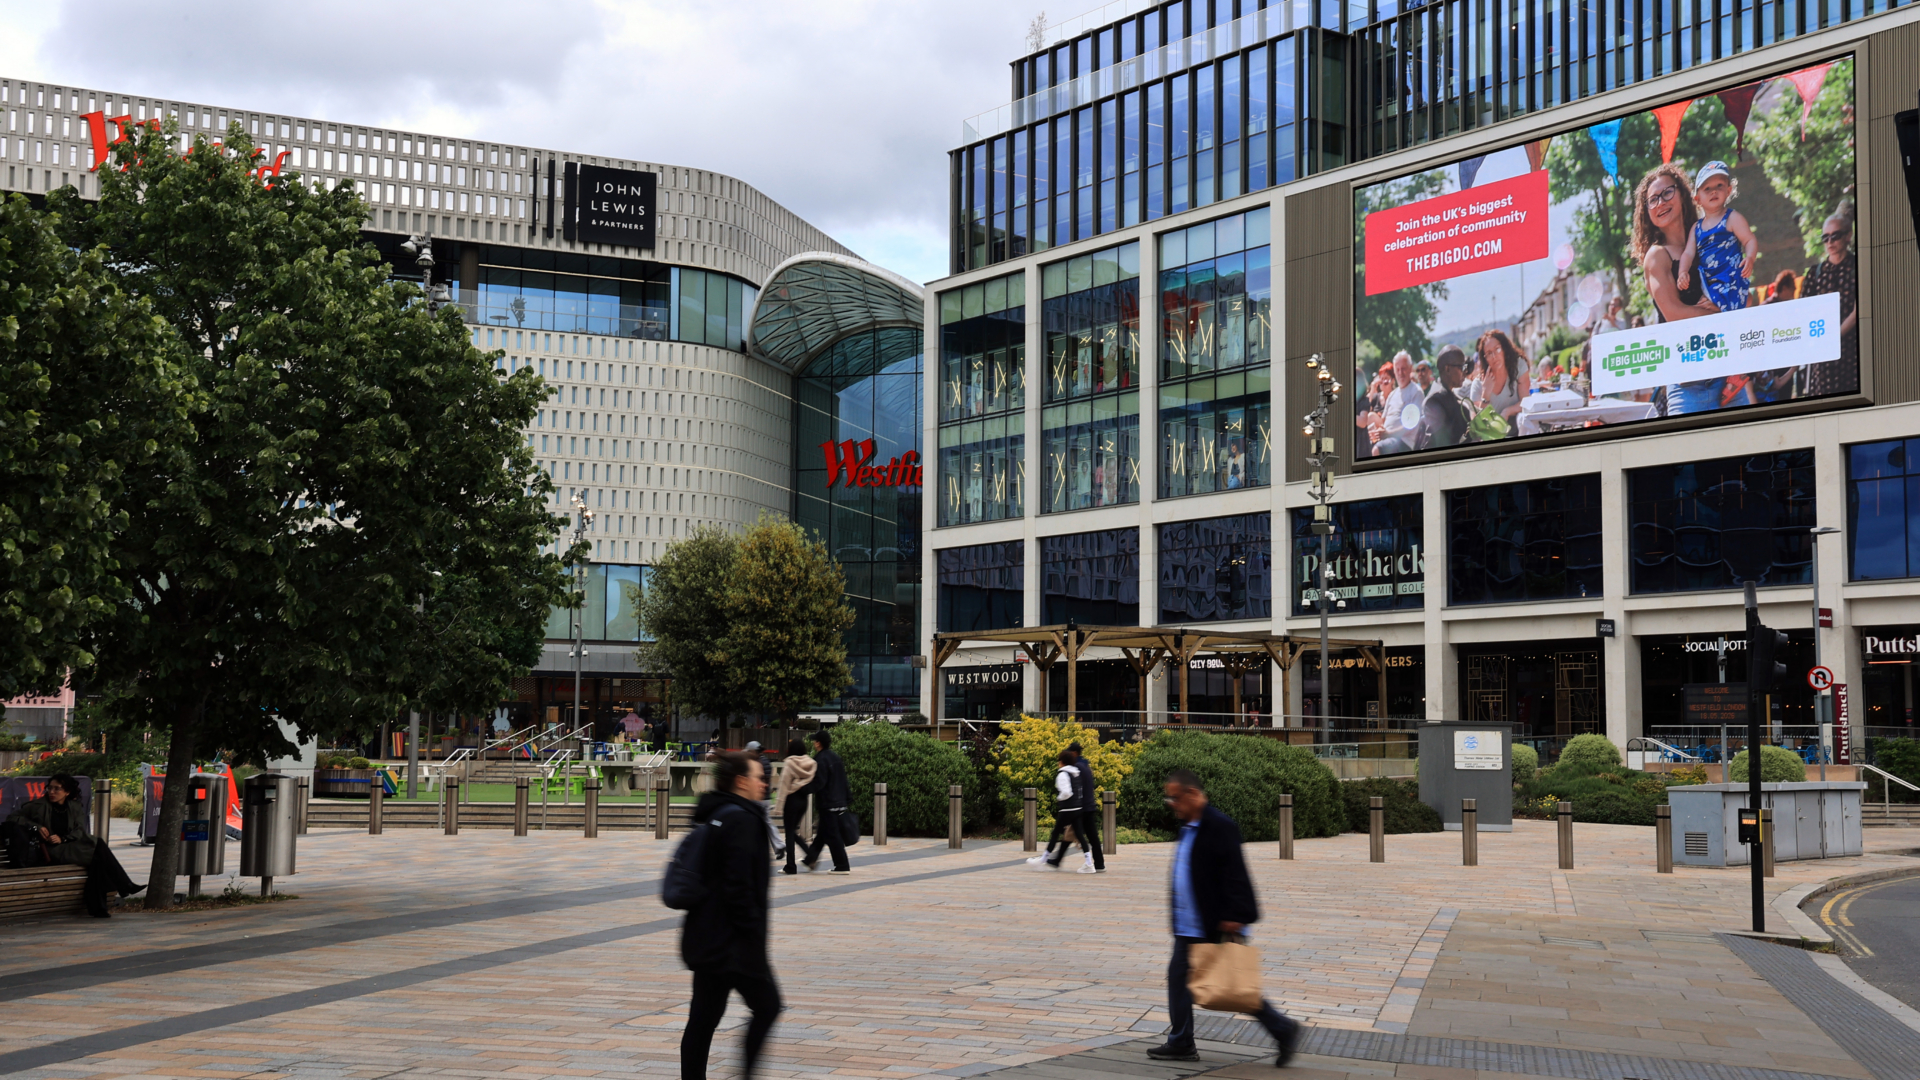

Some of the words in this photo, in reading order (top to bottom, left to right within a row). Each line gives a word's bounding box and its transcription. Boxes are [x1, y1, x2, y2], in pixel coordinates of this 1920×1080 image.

[595, 181, 641, 196] JOHN
[591, 200, 645, 215] LEWIS
[1396, 218, 1420, 233] Join
[1421, 215, 1441, 227] the
[1469, 194, 1513, 216] biggest
[599, 220, 644, 230] PARTNERS
[1384, 229, 1446, 252] celebration
[1447, 224, 1460, 237] of
[1461, 210, 1527, 234] community
[1406, 238, 1502, 273] THEBIGDO.COM
[1739, 329, 1765, 342] eden
[1772, 326, 1802, 338] Pears
[1739, 338, 1765, 351] project
[1771, 335, 1802, 344] Foundation
[1615, 354, 1630, 367] BIG
[1632, 349, 1661, 364] LUNCH
[1707, 348, 1730, 360] OUT
[818, 438, 923, 489] Westfie
[1306, 591, 1321, 600] BA
[1377, 585, 1394, 594] MIN
[1685, 641, 1719, 653] SOCIAL
[1723, 639, 1747, 651] POTT
[1190, 659, 1206, 669] CITY
[1316, 658, 1343, 670] JVA
[1356, 656, 1413, 668] WKERS
[948, 671, 1019, 685] WESTWOOD
[1704, 686, 1730, 694] WELCOME
[1713, 695, 1721, 703] TO
[1689, 703, 1721, 711] WESTFIELD
[1723, 703, 1746, 711] LONDON
[1838, 686, 1849, 760] Puttshack
